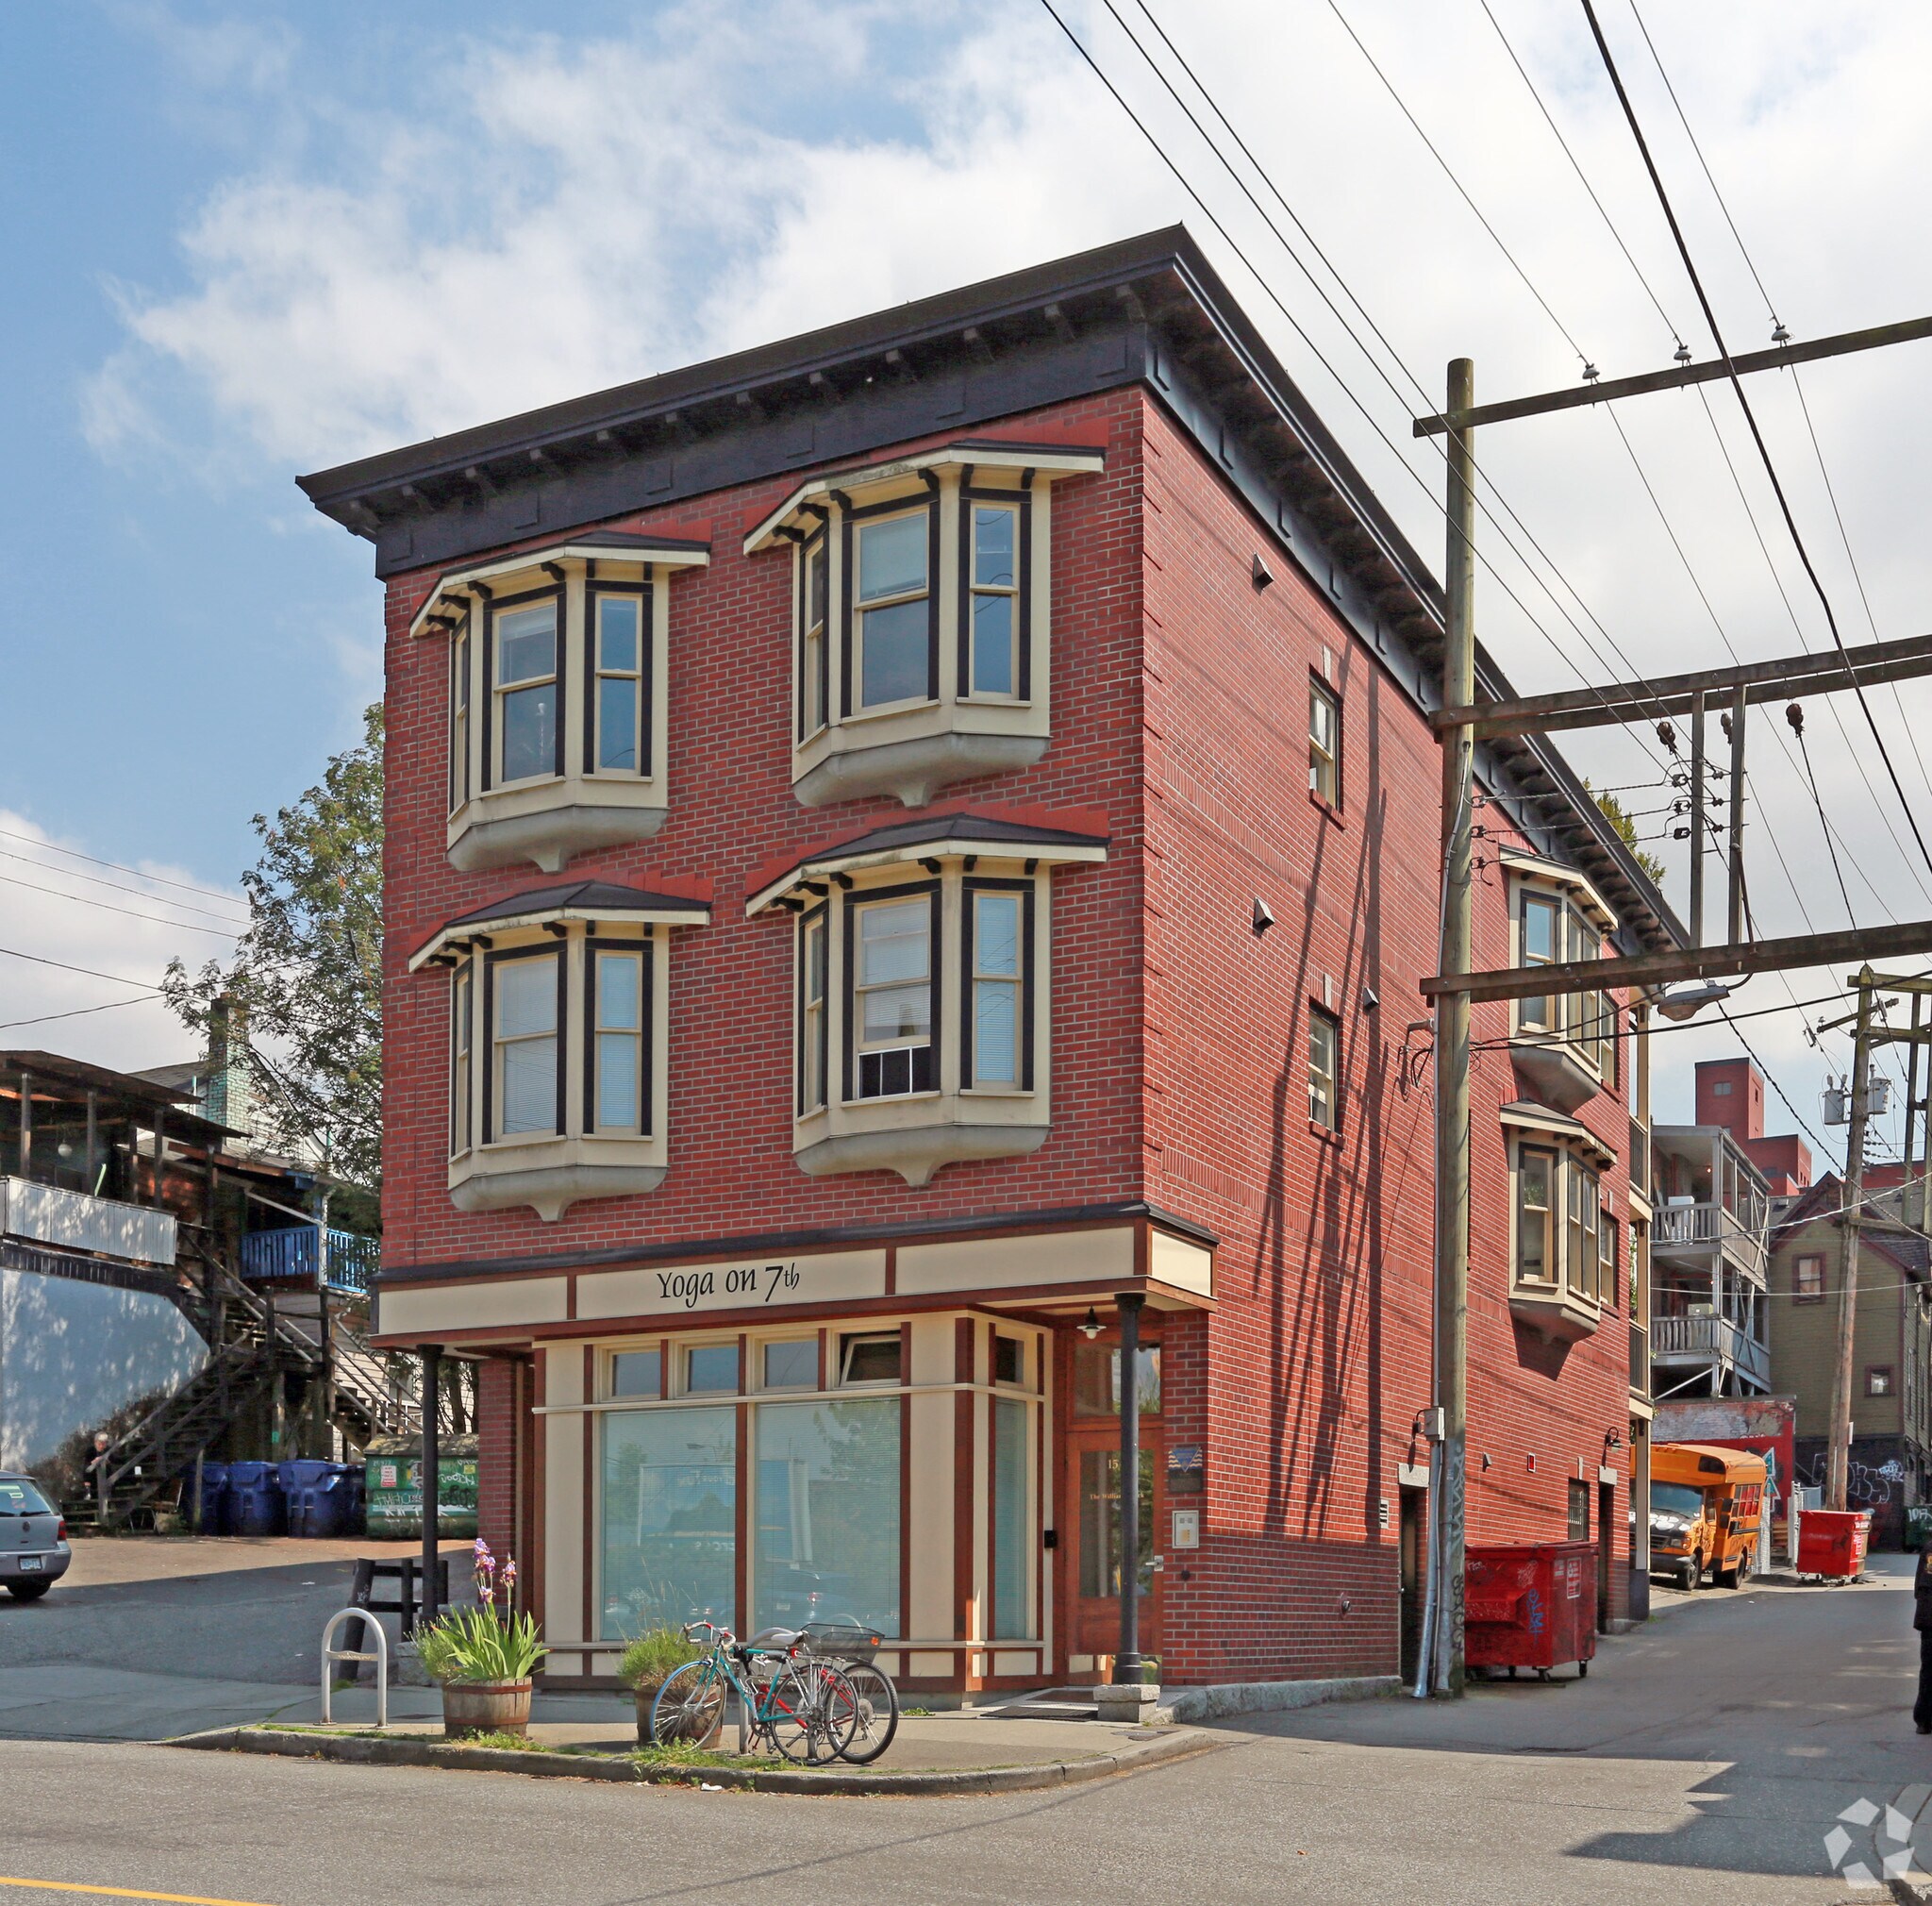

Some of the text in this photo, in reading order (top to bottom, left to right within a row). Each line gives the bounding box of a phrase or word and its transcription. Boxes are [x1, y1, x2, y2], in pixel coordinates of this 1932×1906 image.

[656, 1262, 800, 1309] Yoga on 7th
